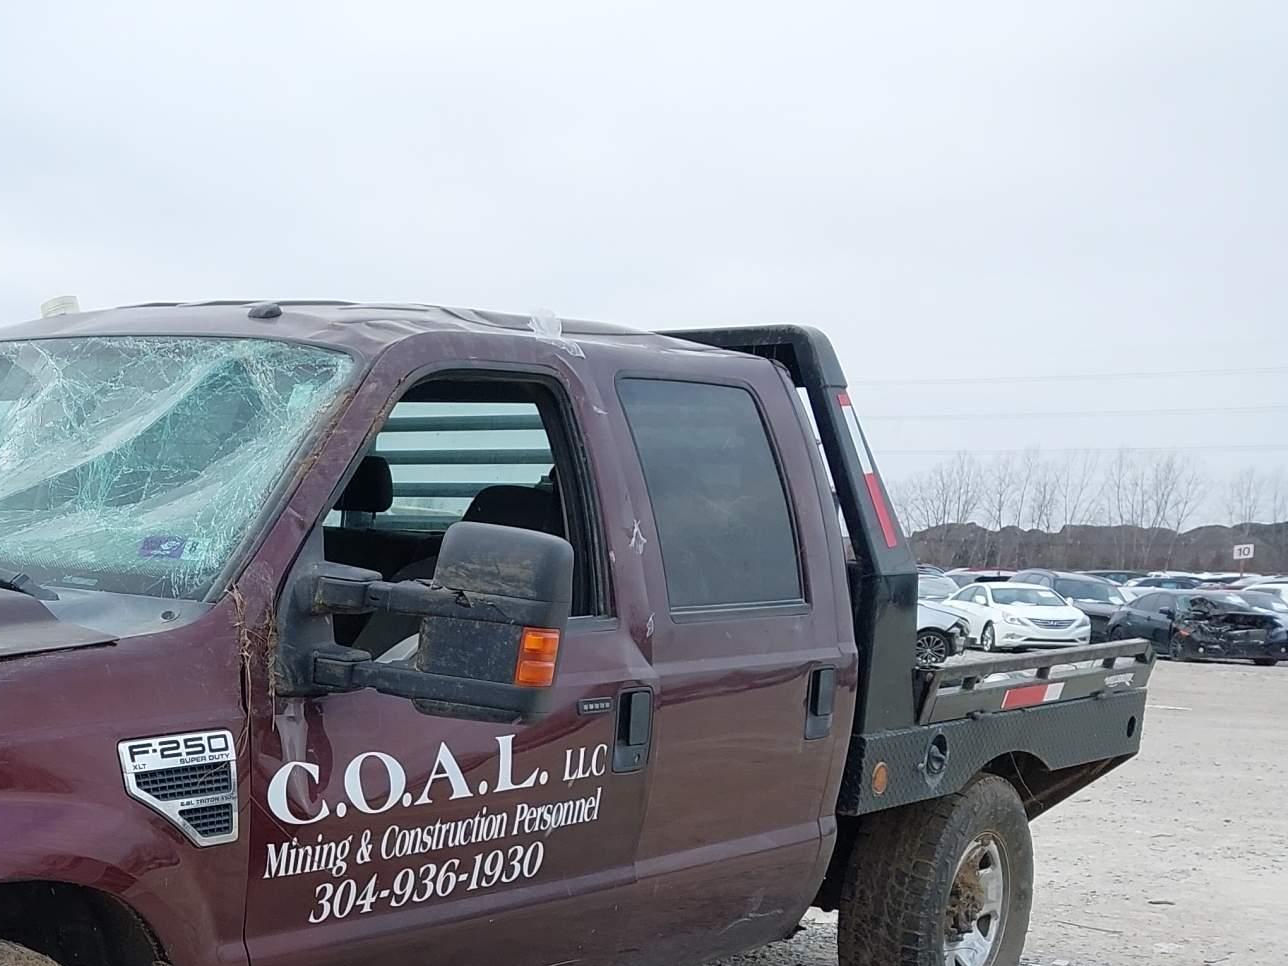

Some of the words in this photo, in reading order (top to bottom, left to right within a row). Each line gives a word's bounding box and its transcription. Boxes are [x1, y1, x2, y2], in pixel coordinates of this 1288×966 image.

[1237, 547, 1250, 557] 10
[128, 734, 229, 763] F-250
[180, 755, 207, 764] SUPER
[209, 752, 230, 761] DUTY
[132, 763, 147, 771] XLT
[267, 734, 549, 825] C.O.A.L.
[563, 744, 608, 781] LLC
[196, 796, 220, 805] TRITON
[263, 833, 353, 878] Mining
[356, 829, 372, 864] &
[381, 807, 508, 860] Construction
[512, 787, 602, 836] Personnel
[308, 841, 544, 924] 304-936-1930
